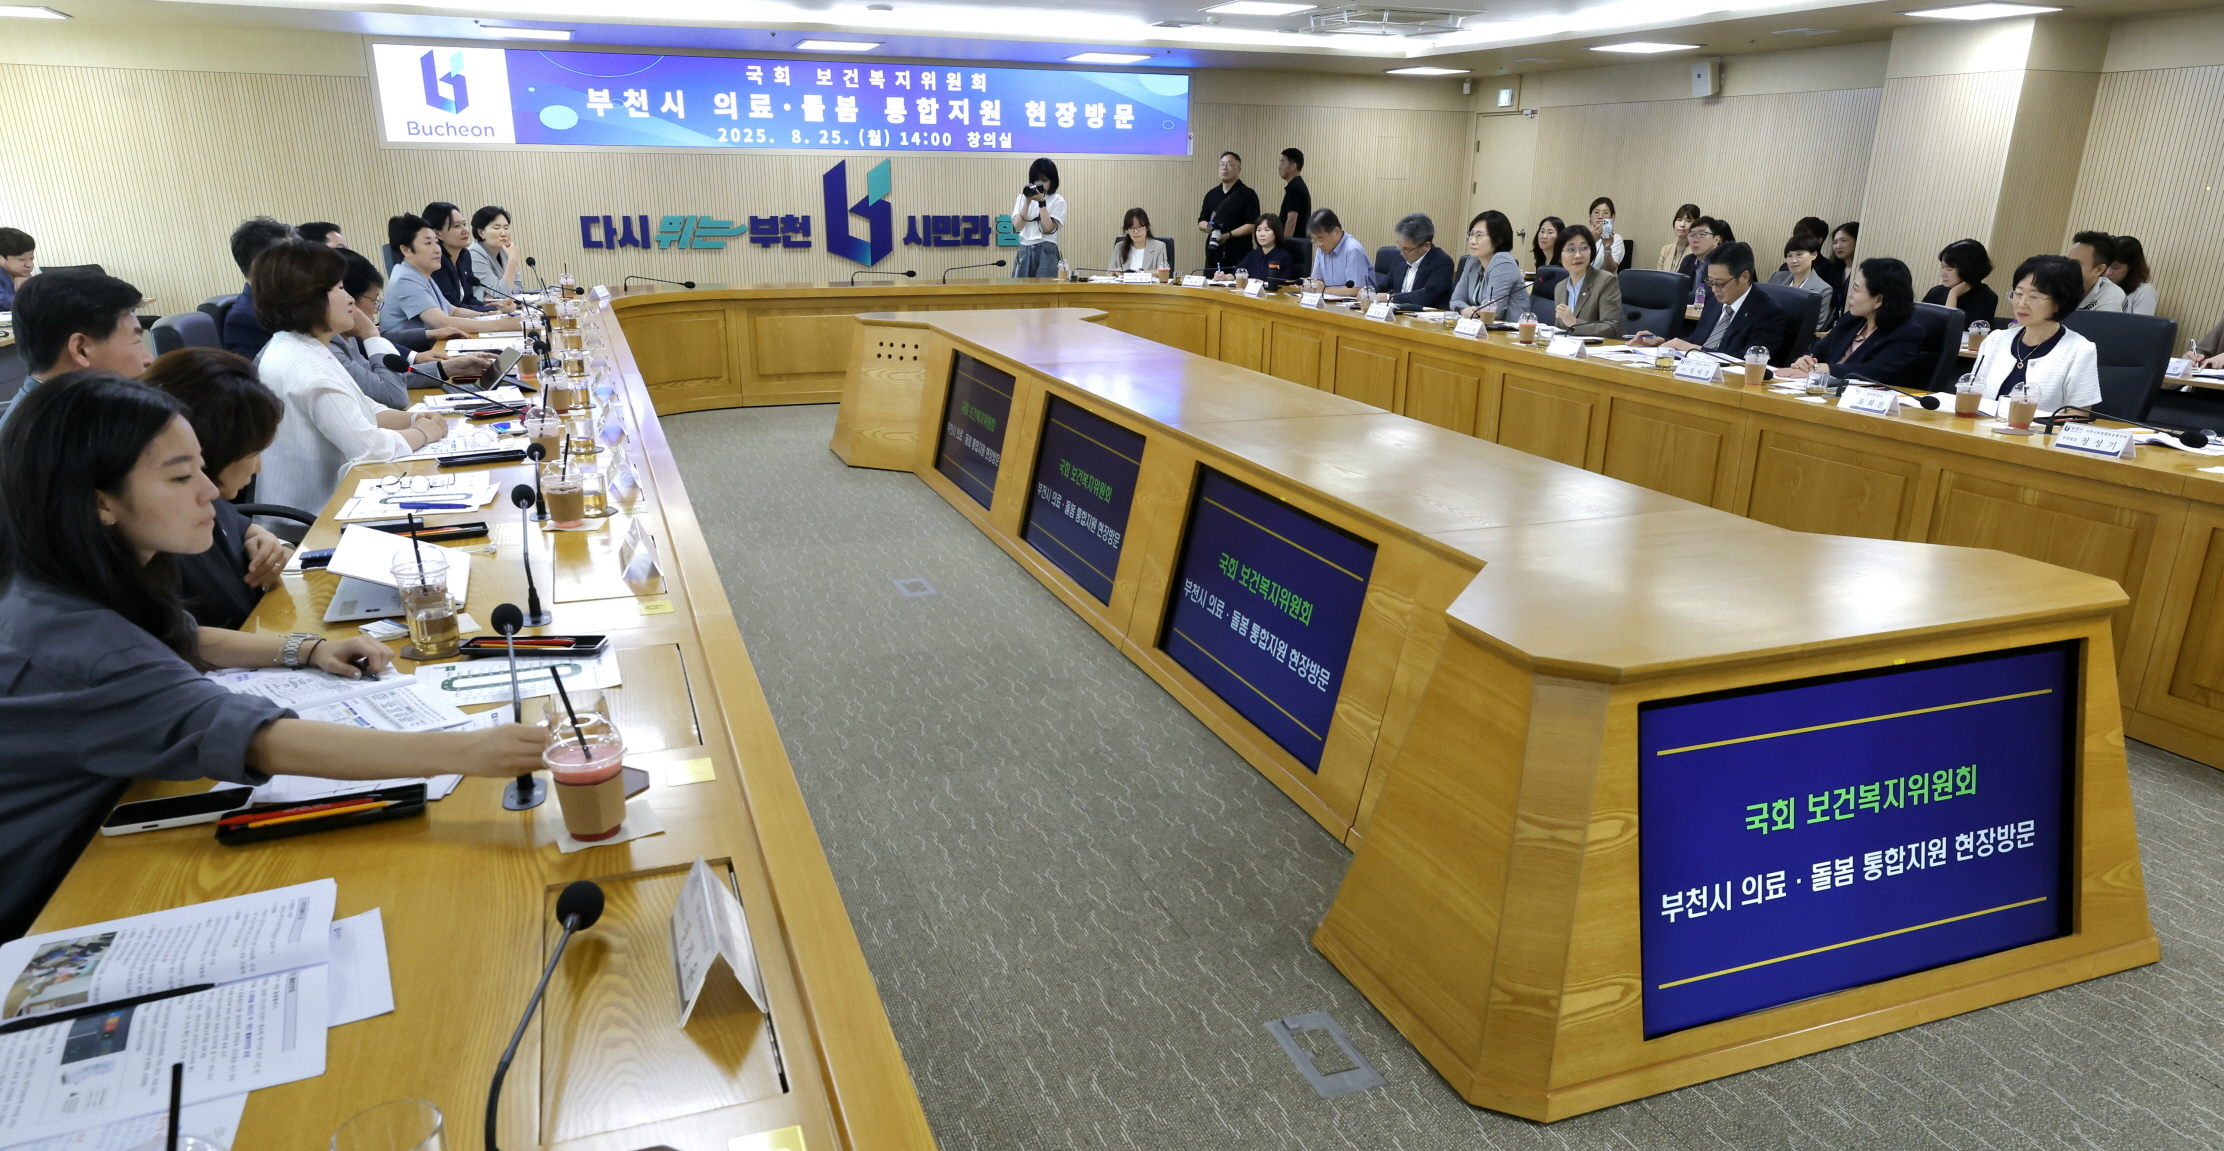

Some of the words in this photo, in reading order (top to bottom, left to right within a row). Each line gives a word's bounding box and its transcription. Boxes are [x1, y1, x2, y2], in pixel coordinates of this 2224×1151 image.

[746, 65, 791, 86] 국회
[816, 68, 987, 92] 보건복지위원회
[406, 121, 495, 137] Bucheon
[586, 88, 686, 119] 부천시
[884, 96, 1001, 126] 통합지원
[1025, 100, 1135, 129] 현장방문
[717, 128, 775, 144] 2025.
[791, 129, 810, 144] 8.
[900, 131, 952, 146] 14:00
[967, 132, 1012, 149] 창의실
[579, 214, 651, 250] 다시
[655, 214, 748, 250] 뛰는
[749, 214, 812, 249] 부천
[903, 214, 991, 248] 시민과
[1059, 458, 1071, 478] 국회
[1070, 465, 1113, 504] 보건복지위원회
[1037, 482, 1052, 502] 부천시
[1051, 491, 1062, 509] 의료
[1064, 500, 1076, 519] 돌봄
[1075, 507, 1097, 534] 통합지원
[1097, 521, 1121, 549] 현장방문
[1218, 552, 1239, 580] 국회
[1238, 564, 1313, 627] 보건복지위원회
[1183, 578, 1208, 609] 부천시
[1207, 594, 1225, 620] 의료
[1230, 610, 1250, 637] 돌봄
[1250, 622, 1288, 663] 통합지원
[1288, 649, 1331, 693] 현장방문
[1745, 797, 1796, 835] 국회
[1806, 764, 1978, 825] 보건복지위원회
[1660, 880, 1732, 923] 부천시
[1740, 870, 1787, 907] 의료
[1811, 856, 1855, 892] 돌봄
[1862, 837, 1947, 882] 통합지원
[1955, 819, 2036, 861] 현장방문
